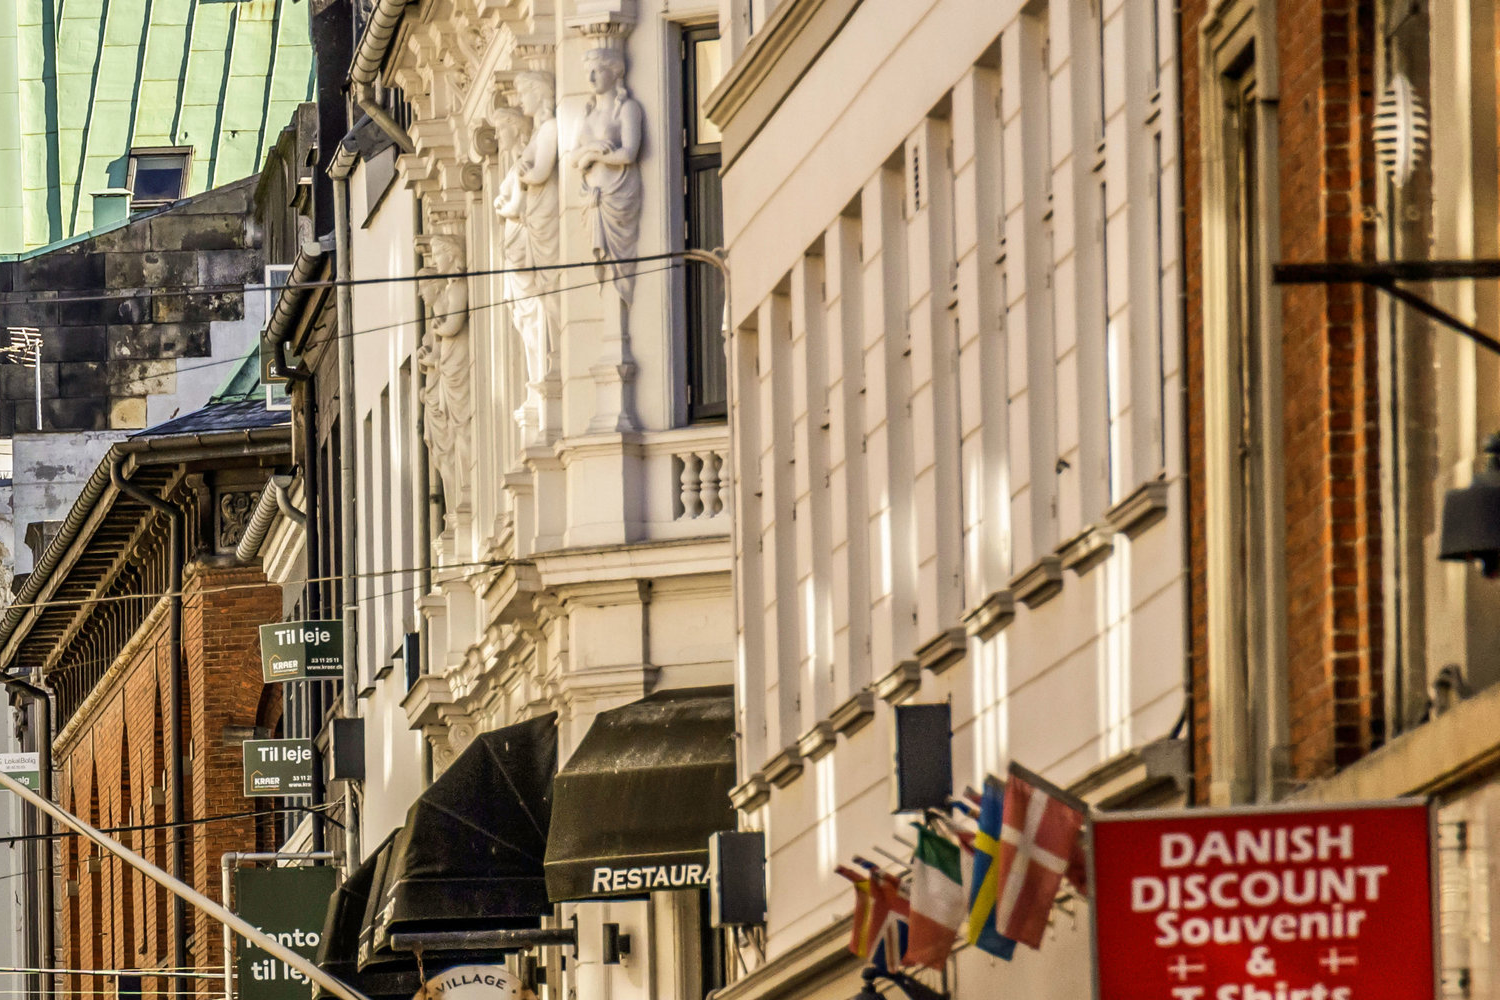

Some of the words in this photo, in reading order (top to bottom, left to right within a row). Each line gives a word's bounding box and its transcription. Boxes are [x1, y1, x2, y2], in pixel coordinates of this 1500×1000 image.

[275, 629, 295, 646] Til
[300, 627, 331, 646] leje
[272, 660, 298, 670] KRAER
[258, 746, 278, 762] Til
[283, 745, 312, 764] leje
[254, 777, 280, 786] KRAER
[1160, 824, 1354, 868] DANISH
[1130, 865, 1389, 912] DISCOUNT
[1154, 903, 1366, 947] Souvenir
[246, 927, 323, 949] onto
[1245, 943, 1276, 977] &
[251, 958, 276, 981] til
[283, 958, 313, 985] lej
[435, 973, 508, 994] VILLAGE
